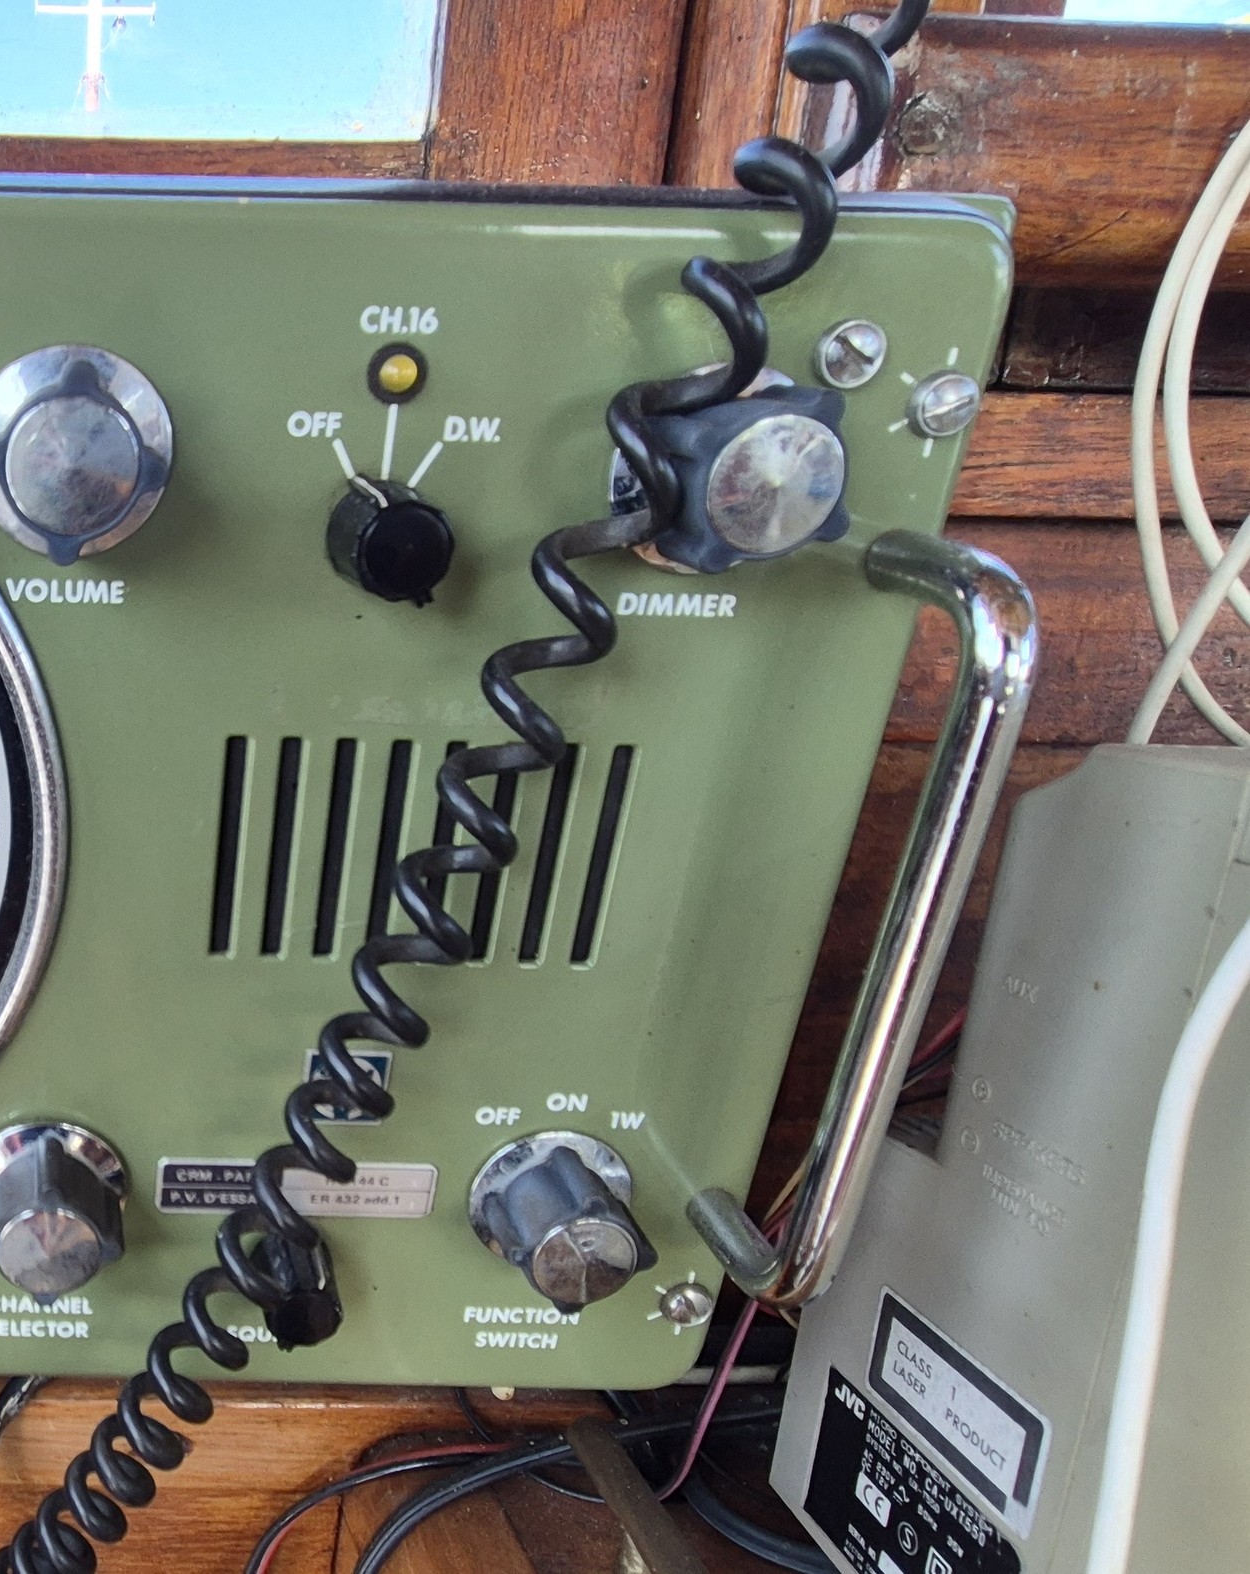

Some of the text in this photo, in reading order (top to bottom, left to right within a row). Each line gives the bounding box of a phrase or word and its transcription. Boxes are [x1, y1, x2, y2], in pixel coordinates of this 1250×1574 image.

[359, 306, 439, 336] CH.16
[286, 410, 344, 440] OFF
[442, 415, 501, 444] D.W.
[5, 577, 126, 604] VOLUME
[615, 592, 738, 619] DIMMER
[474, 1106, 522, 1126] OFF
[546, 1092, 589, 1112] ON
[610, 1111, 646, 1130] 1W
[463, 1307, 581, 1326] FUNCTION
[475, 1331, 559, 1350] SWITCH
[896, 1339, 933, 1380] CLASS
[834, 1383, 866, 1421] JVC
[892, 1359, 1007, 1472] LASER PRODUCT
[867, 1418, 897, 1457] MODEL
[902, 1454, 919, 1479] NO.
[870, 1408, 898, 1440] MICRO
[900, 1439, 951, 1493] COMPONENT
